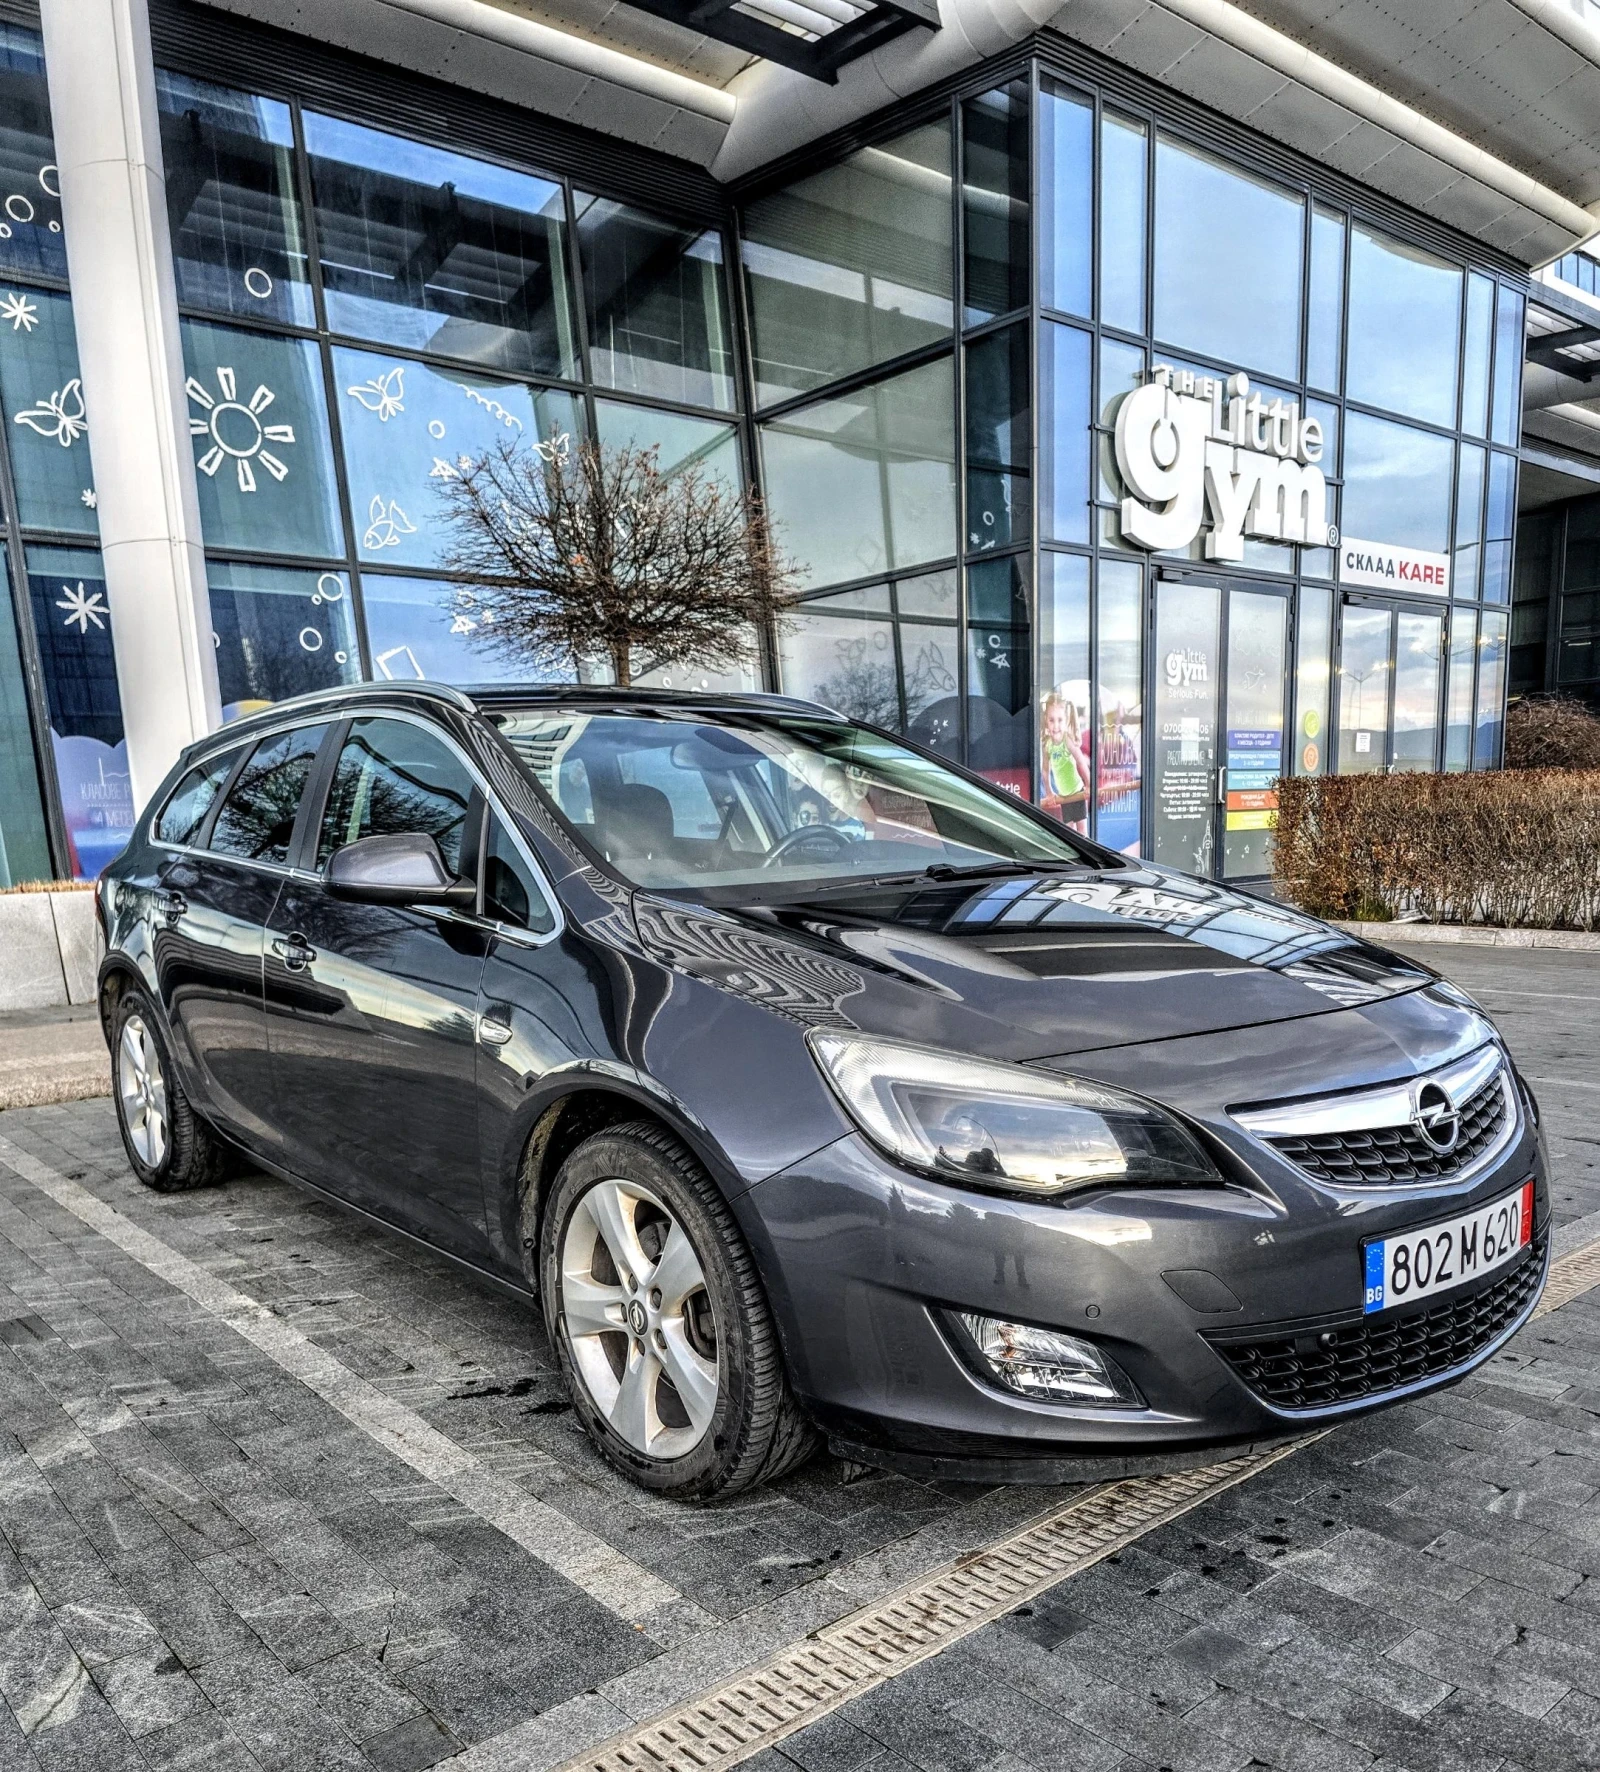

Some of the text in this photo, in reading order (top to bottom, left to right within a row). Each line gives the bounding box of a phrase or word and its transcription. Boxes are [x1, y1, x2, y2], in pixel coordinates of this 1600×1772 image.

[1152, 363, 1214, 399] THE
[1211, 372, 1324, 464] Little
[1113, 383, 1329, 562] gym
[1346, 552, 1445, 586] СКЛАД KARE
[1166, 652, 1208, 687] gym
[1183, 647, 1207, 664] Little
[1366, 1285, 1383, 1304] BG
